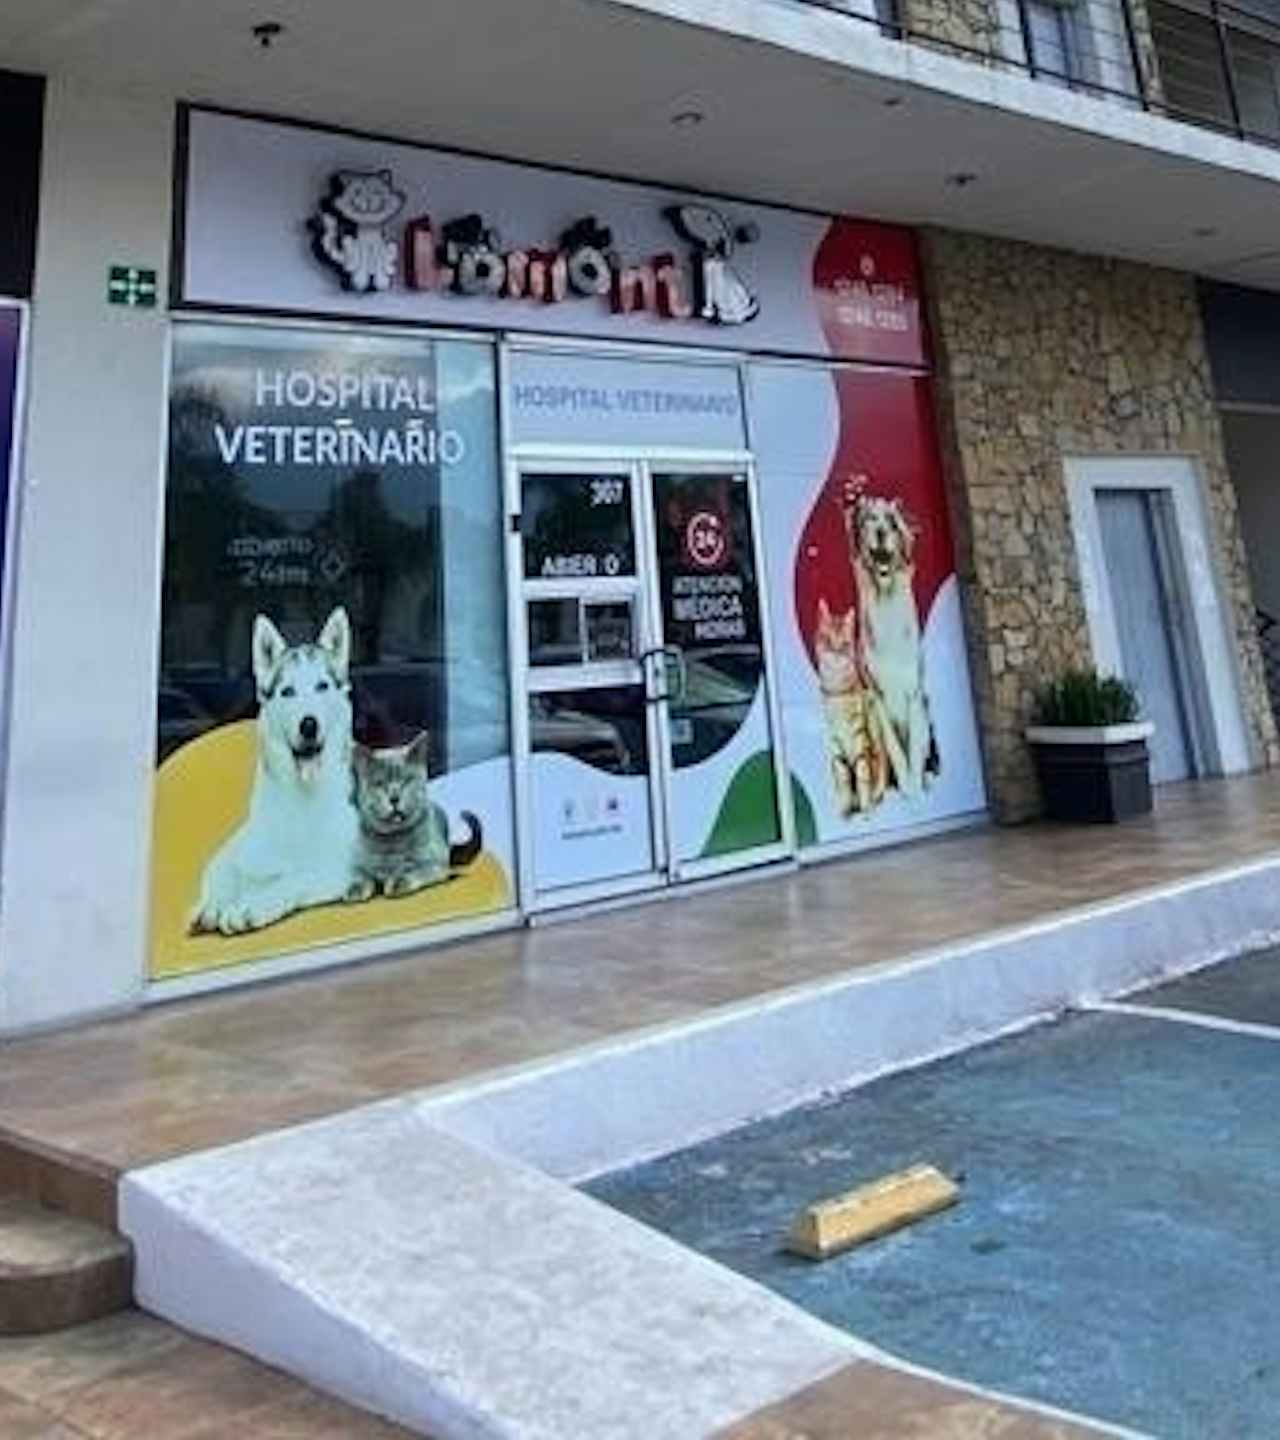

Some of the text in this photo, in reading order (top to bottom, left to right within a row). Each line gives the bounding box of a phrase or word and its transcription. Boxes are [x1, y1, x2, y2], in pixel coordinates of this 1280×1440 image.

[255, 368, 435, 411] HOSPITAL
[513, 383, 608, 411] HOSPITAL
[214, 424, 465, 465] VETERINARIO
[540, 555, 620, 576] ABIERO
